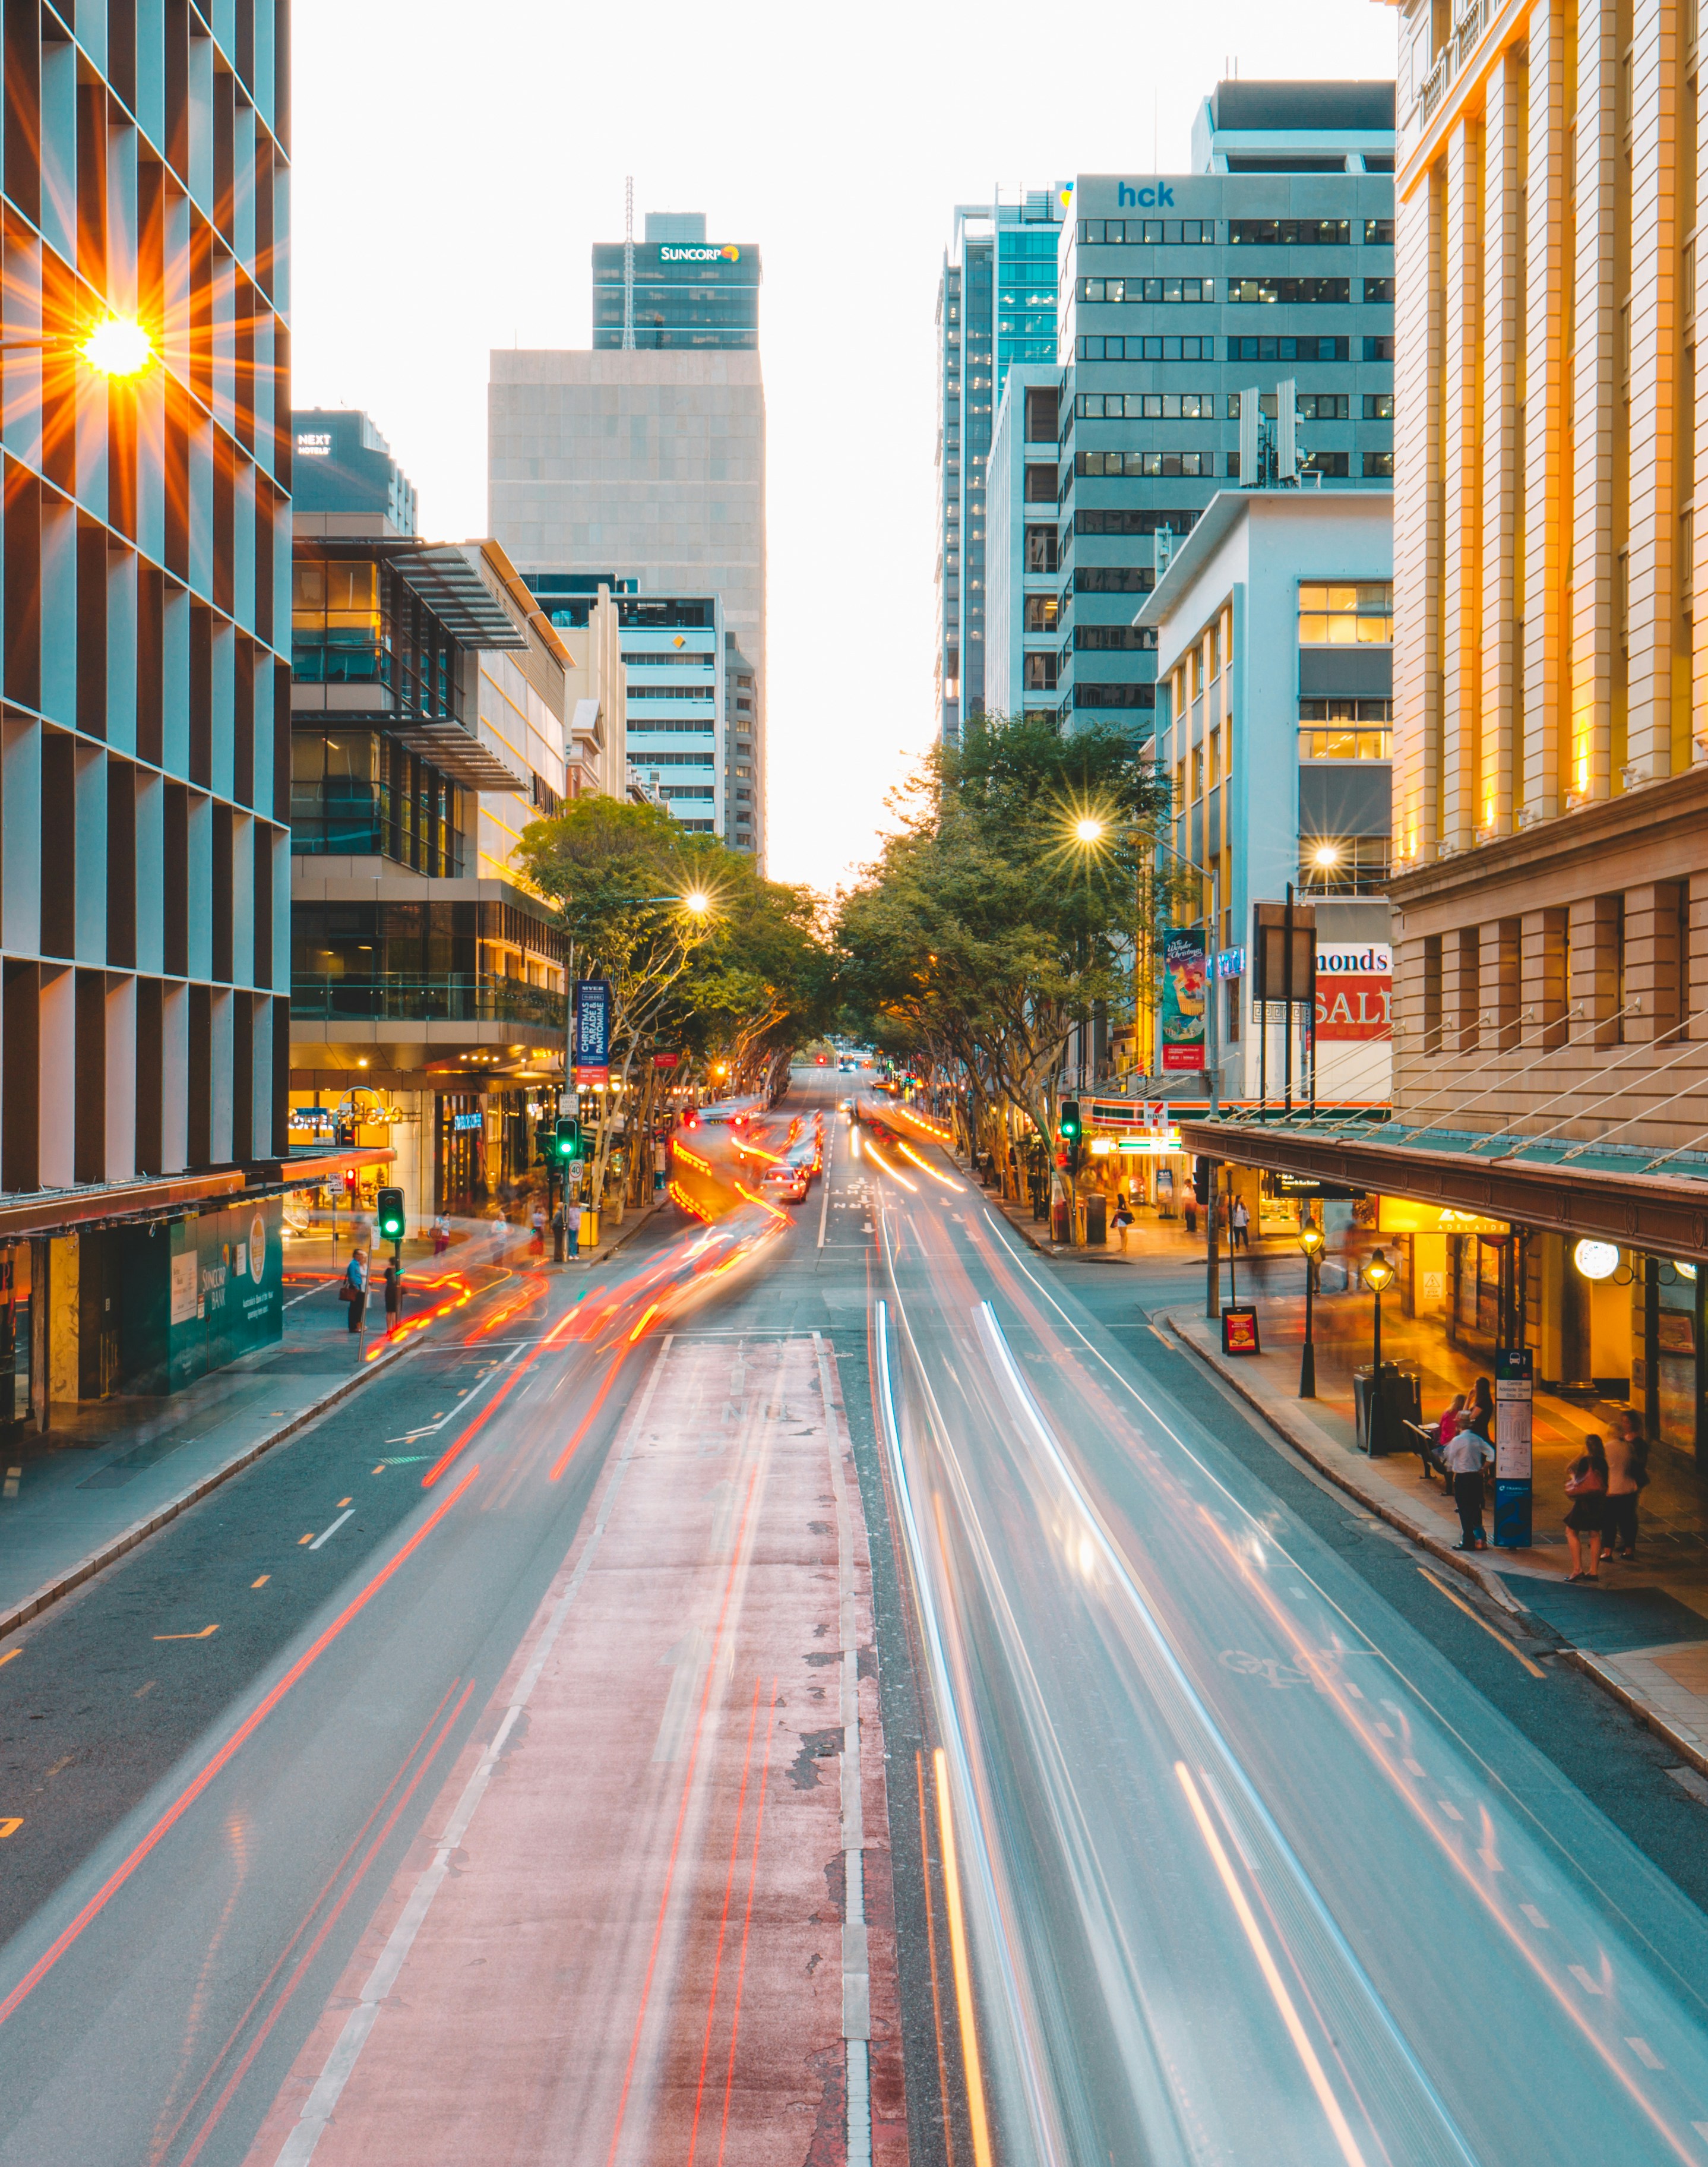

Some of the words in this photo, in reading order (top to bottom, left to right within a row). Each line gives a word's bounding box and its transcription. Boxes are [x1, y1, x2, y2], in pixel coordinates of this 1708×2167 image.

[1118, 181, 1175, 207] hck
[661, 247, 721, 260] SUNCORP
[298, 434, 331, 445] NEXT
[1168, 941, 1193, 952] Wonder
[1171, 948, 1203, 962] Christmas
[589, 1010, 597, 1044] PARADE
[1152, 1102, 1164, 1126] 7
